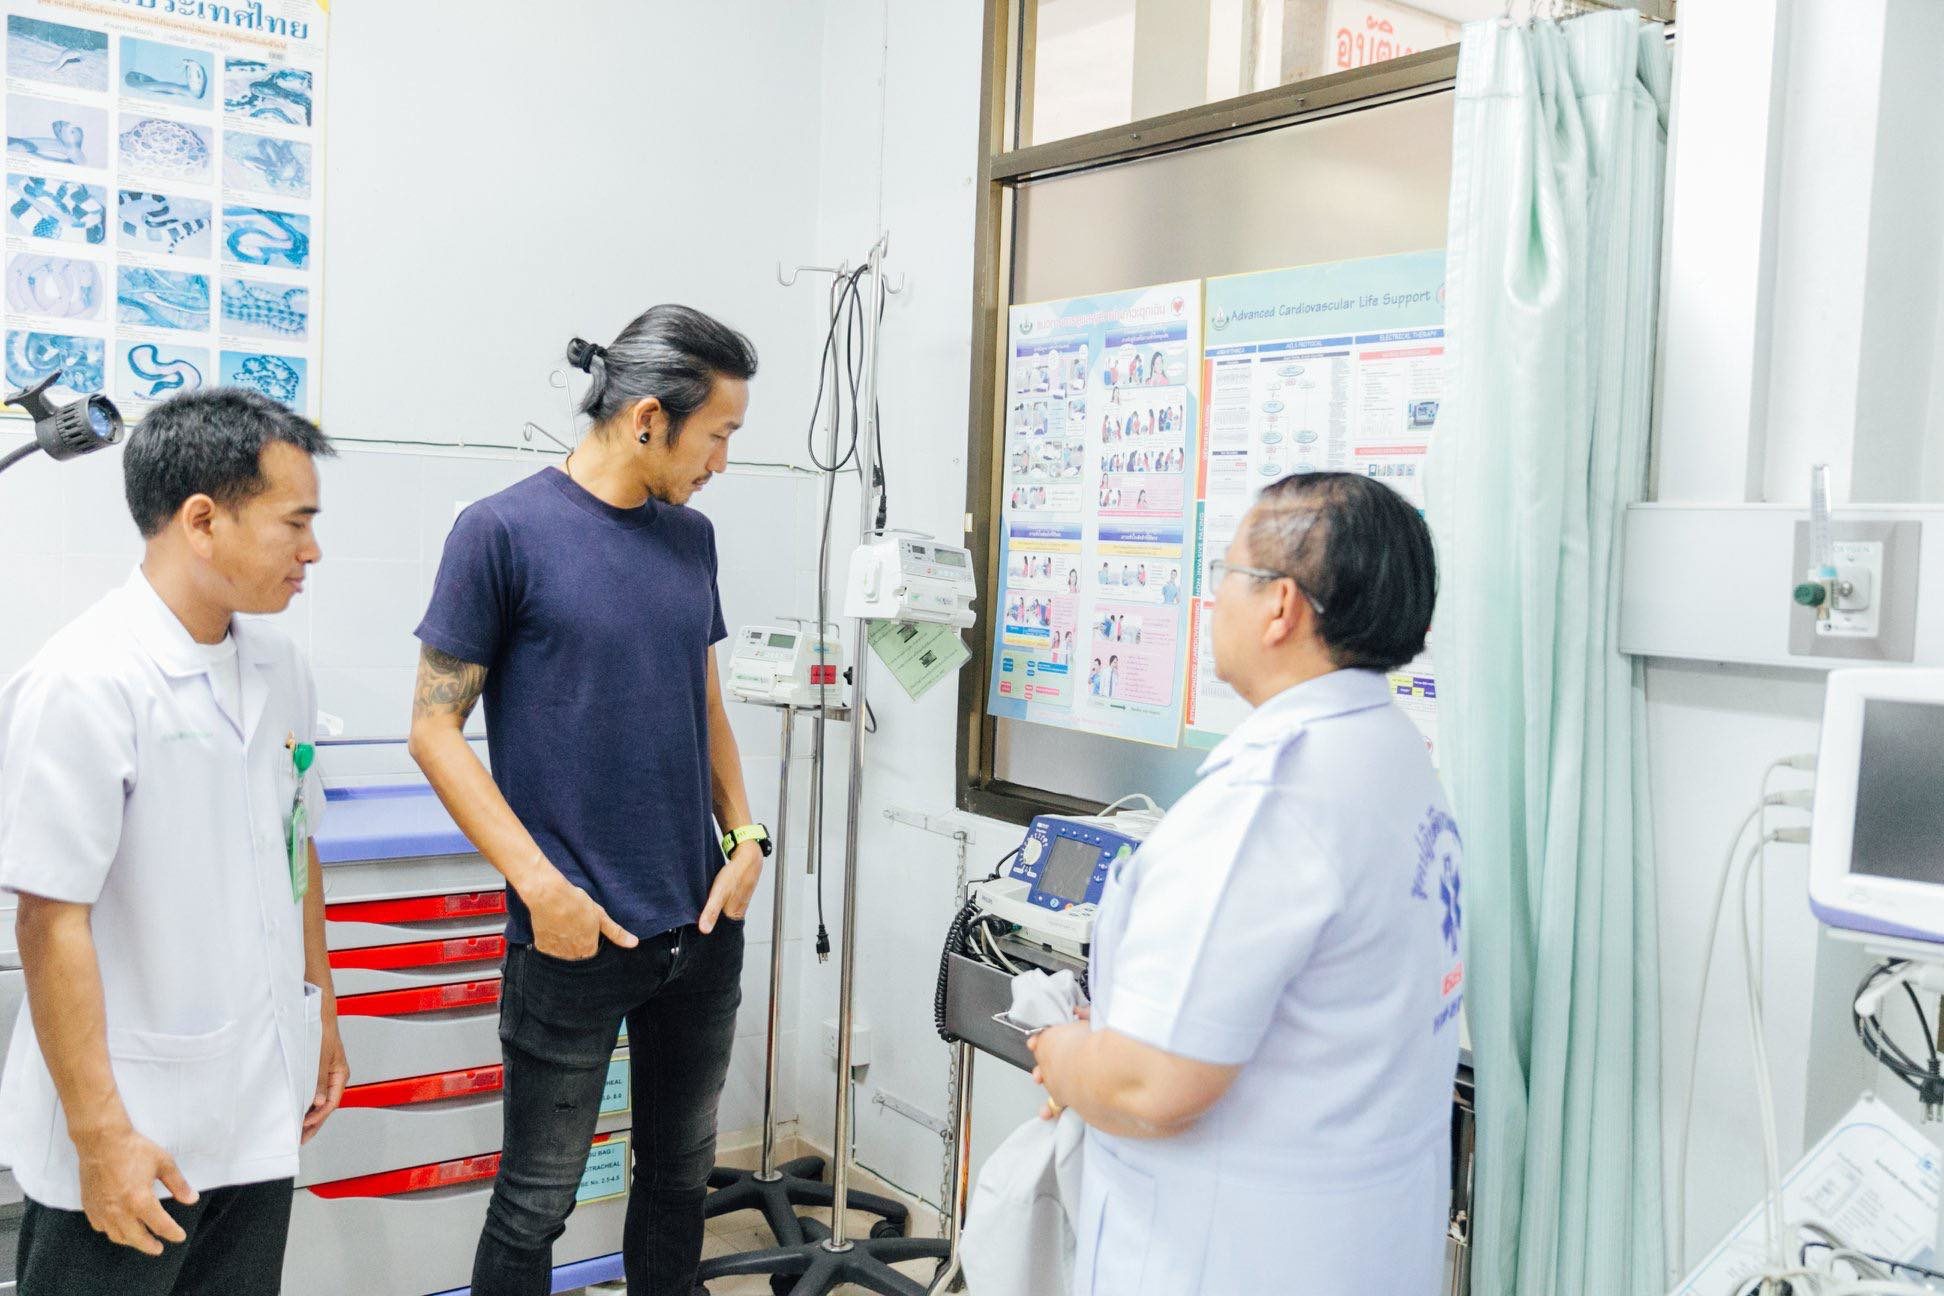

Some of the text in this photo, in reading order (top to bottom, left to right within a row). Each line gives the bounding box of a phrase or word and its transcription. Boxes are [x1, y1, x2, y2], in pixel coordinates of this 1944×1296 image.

[118, 0, 309, 39] ระเทศไทย
[1231, 289, 1432, 321] Advanced Cardiovascular Life Support
[585, 1162, 621, 1173] OTRACHEAL
